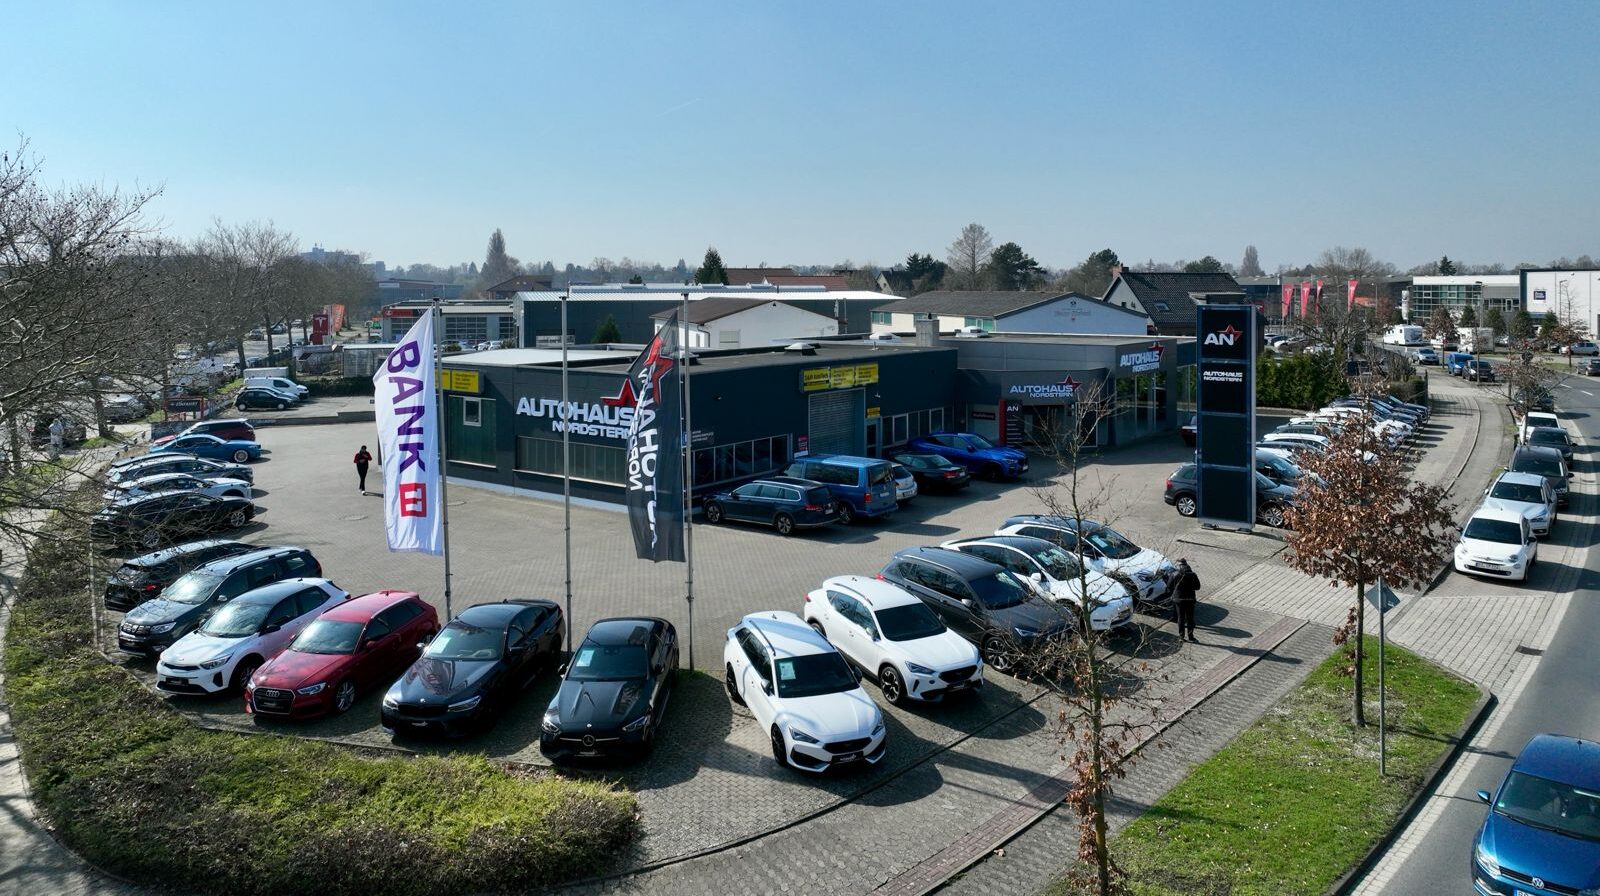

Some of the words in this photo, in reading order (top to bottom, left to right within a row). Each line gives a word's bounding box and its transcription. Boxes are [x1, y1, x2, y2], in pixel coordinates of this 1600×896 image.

[1203, 332, 1234, 346] AN
[1120, 350, 1159, 367] AUTOHAUS
[1203, 370, 1243, 378] AUTOHAUS
[1009, 384, 1073, 394] AUTOHAUS
[387, 340, 425, 474] BANK
[516, 396, 634, 428] AUTOHAUS
